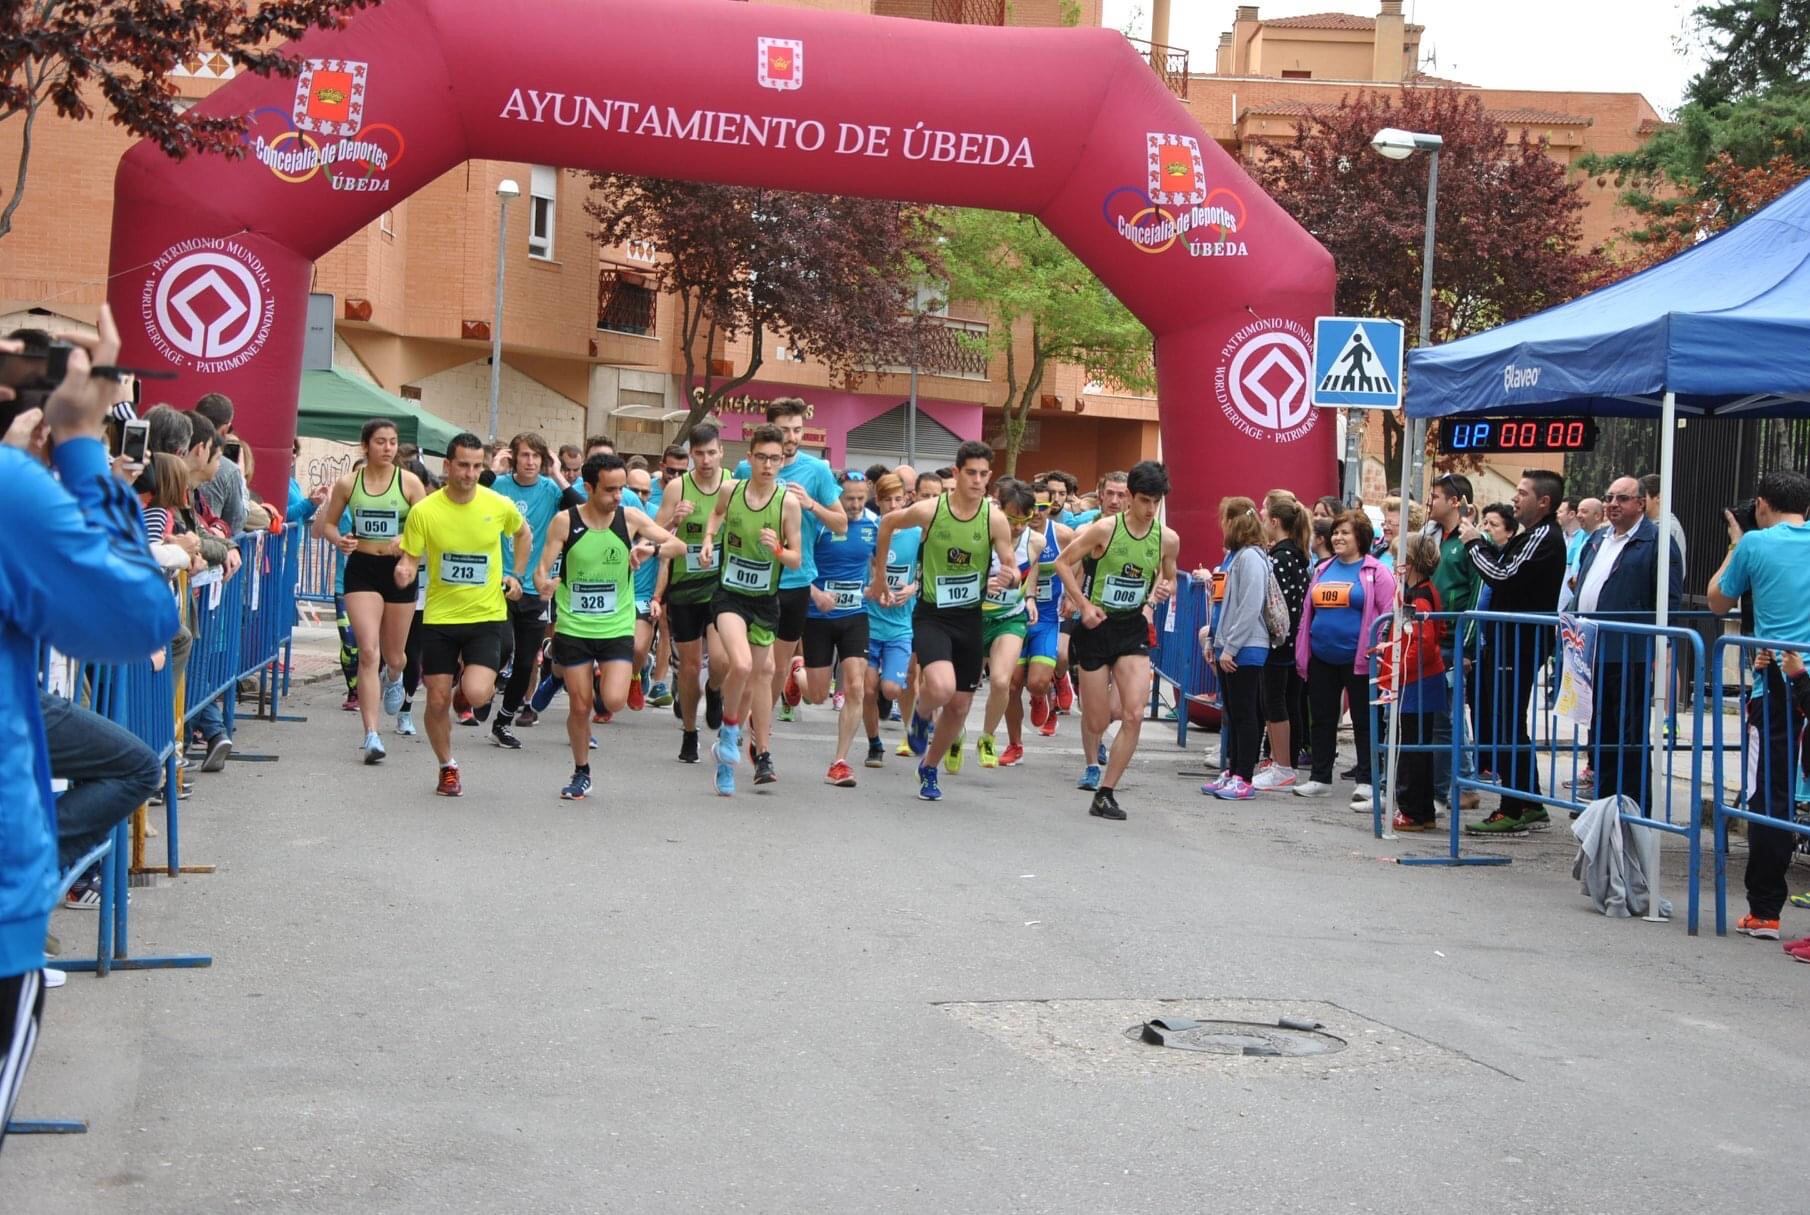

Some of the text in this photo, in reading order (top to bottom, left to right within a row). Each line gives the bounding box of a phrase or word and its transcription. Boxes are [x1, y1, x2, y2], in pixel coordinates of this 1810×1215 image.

[499, 87, 1035, 168] AYUNTAMIENTO DE ÚBEDA
[255, 135, 388, 174] Concejalía de Deportes
[331, 171, 390, 192] ÚBEDA
[1117, 206, 1237, 246] Concejalía de Deportes
[1189, 238, 1249, 257] ÚBEDA
[152, 237, 271, 289] PATRIMONIO MUNDIAL
[141, 279, 185, 366] WORLD HERITAGE
[195, 295, 275, 374] PATRIMOINE MONDIAL
[1221, 317, 1314, 358] PATRIMONIO MUNDI
[1214, 366, 1264, 440] WORLD HERITAGE
[1275, 410, 1320, 444] PATRIMOINE
[1453, 423, 1490, 448] UP
[364, 520, 388, 533] 050
[451, 565, 474, 580] 213
[736, 569, 759, 585] 010
[580, 595, 605, 609] 328
[948, 587, 969, 600] 102
[1113, 589, 1136, 603] 008
[1322, 590, 1339, 602] 109
